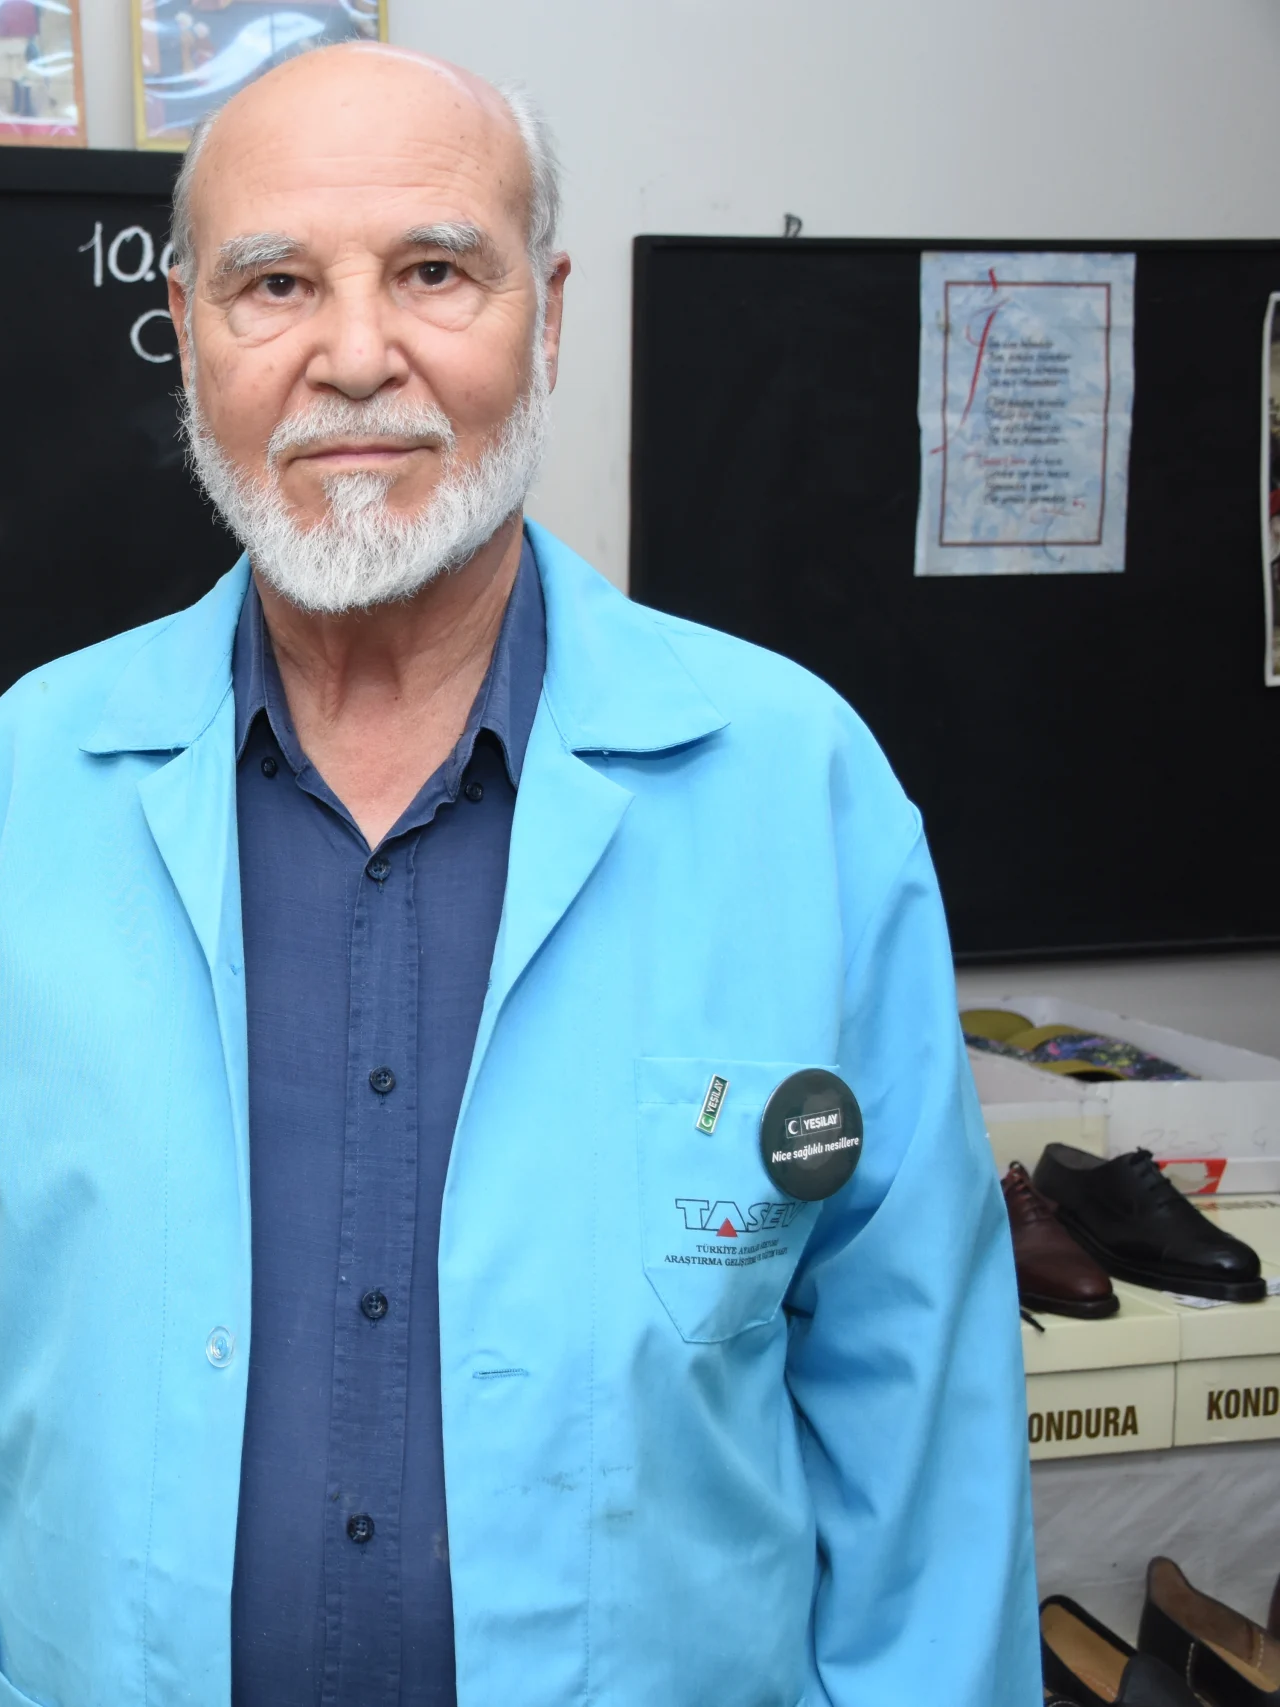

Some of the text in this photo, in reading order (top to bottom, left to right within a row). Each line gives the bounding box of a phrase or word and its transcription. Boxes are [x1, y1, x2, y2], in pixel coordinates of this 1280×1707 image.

[771, 1137, 859, 1163] Nice sağlıklı nesillere
[664, 1254, 723, 1266] ARAŞTIRMA
[1207, 1386, 1280, 1421] KOND
[1028, 1405, 1139, 1444] ONDURA
